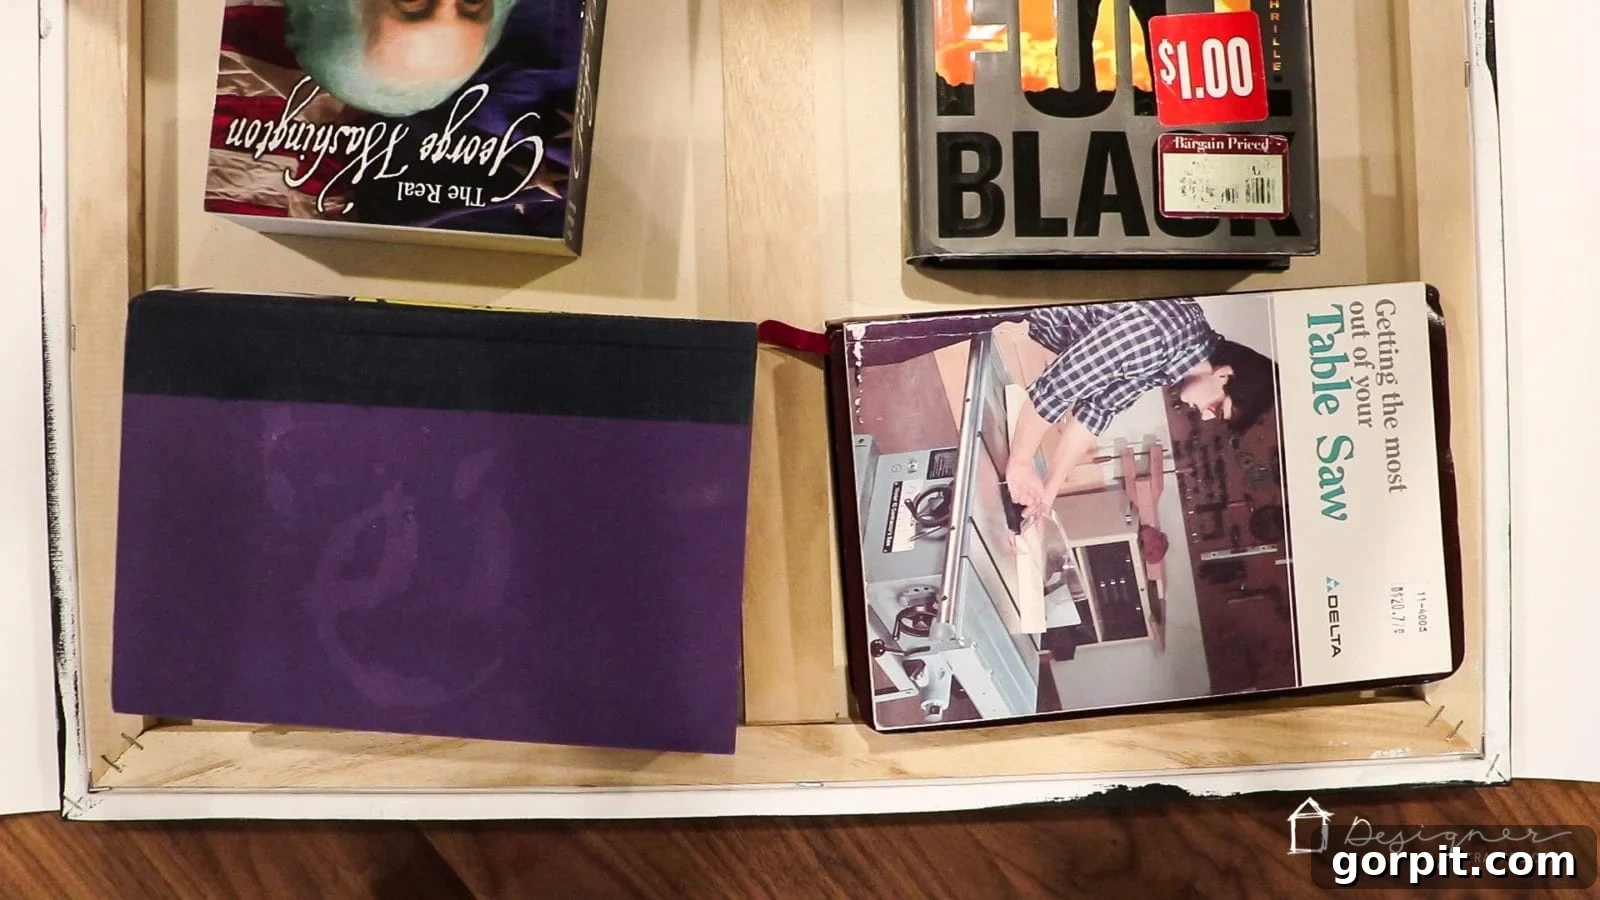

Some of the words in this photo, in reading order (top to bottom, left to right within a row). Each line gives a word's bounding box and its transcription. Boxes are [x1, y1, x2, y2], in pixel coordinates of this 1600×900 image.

[1158, 36, 1255, 100] $1.00
[226, 75, 409, 214] Washington
[419, 83, 544, 203] George
[1173, 136, 1224, 152] Bargain
[1228, 137, 1269, 152] Priced
[398, 181, 440, 204] Real
[448, 184, 485, 208] The
[936, 131, 1301, 238] BLA
[1349, 300, 1370, 340] out
[1375, 299, 1400, 386] Getting
[1306, 303, 1353, 415] Table
[1352, 346, 1375, 370] of
[1350, 375, 1373, 428] your
[1382, 392, 1404, 430] the
[1316, 435, 1355, 522] Saw
[1385, 436, 1408, 493] most
[1327, 595, 1342, 658] DELTA
